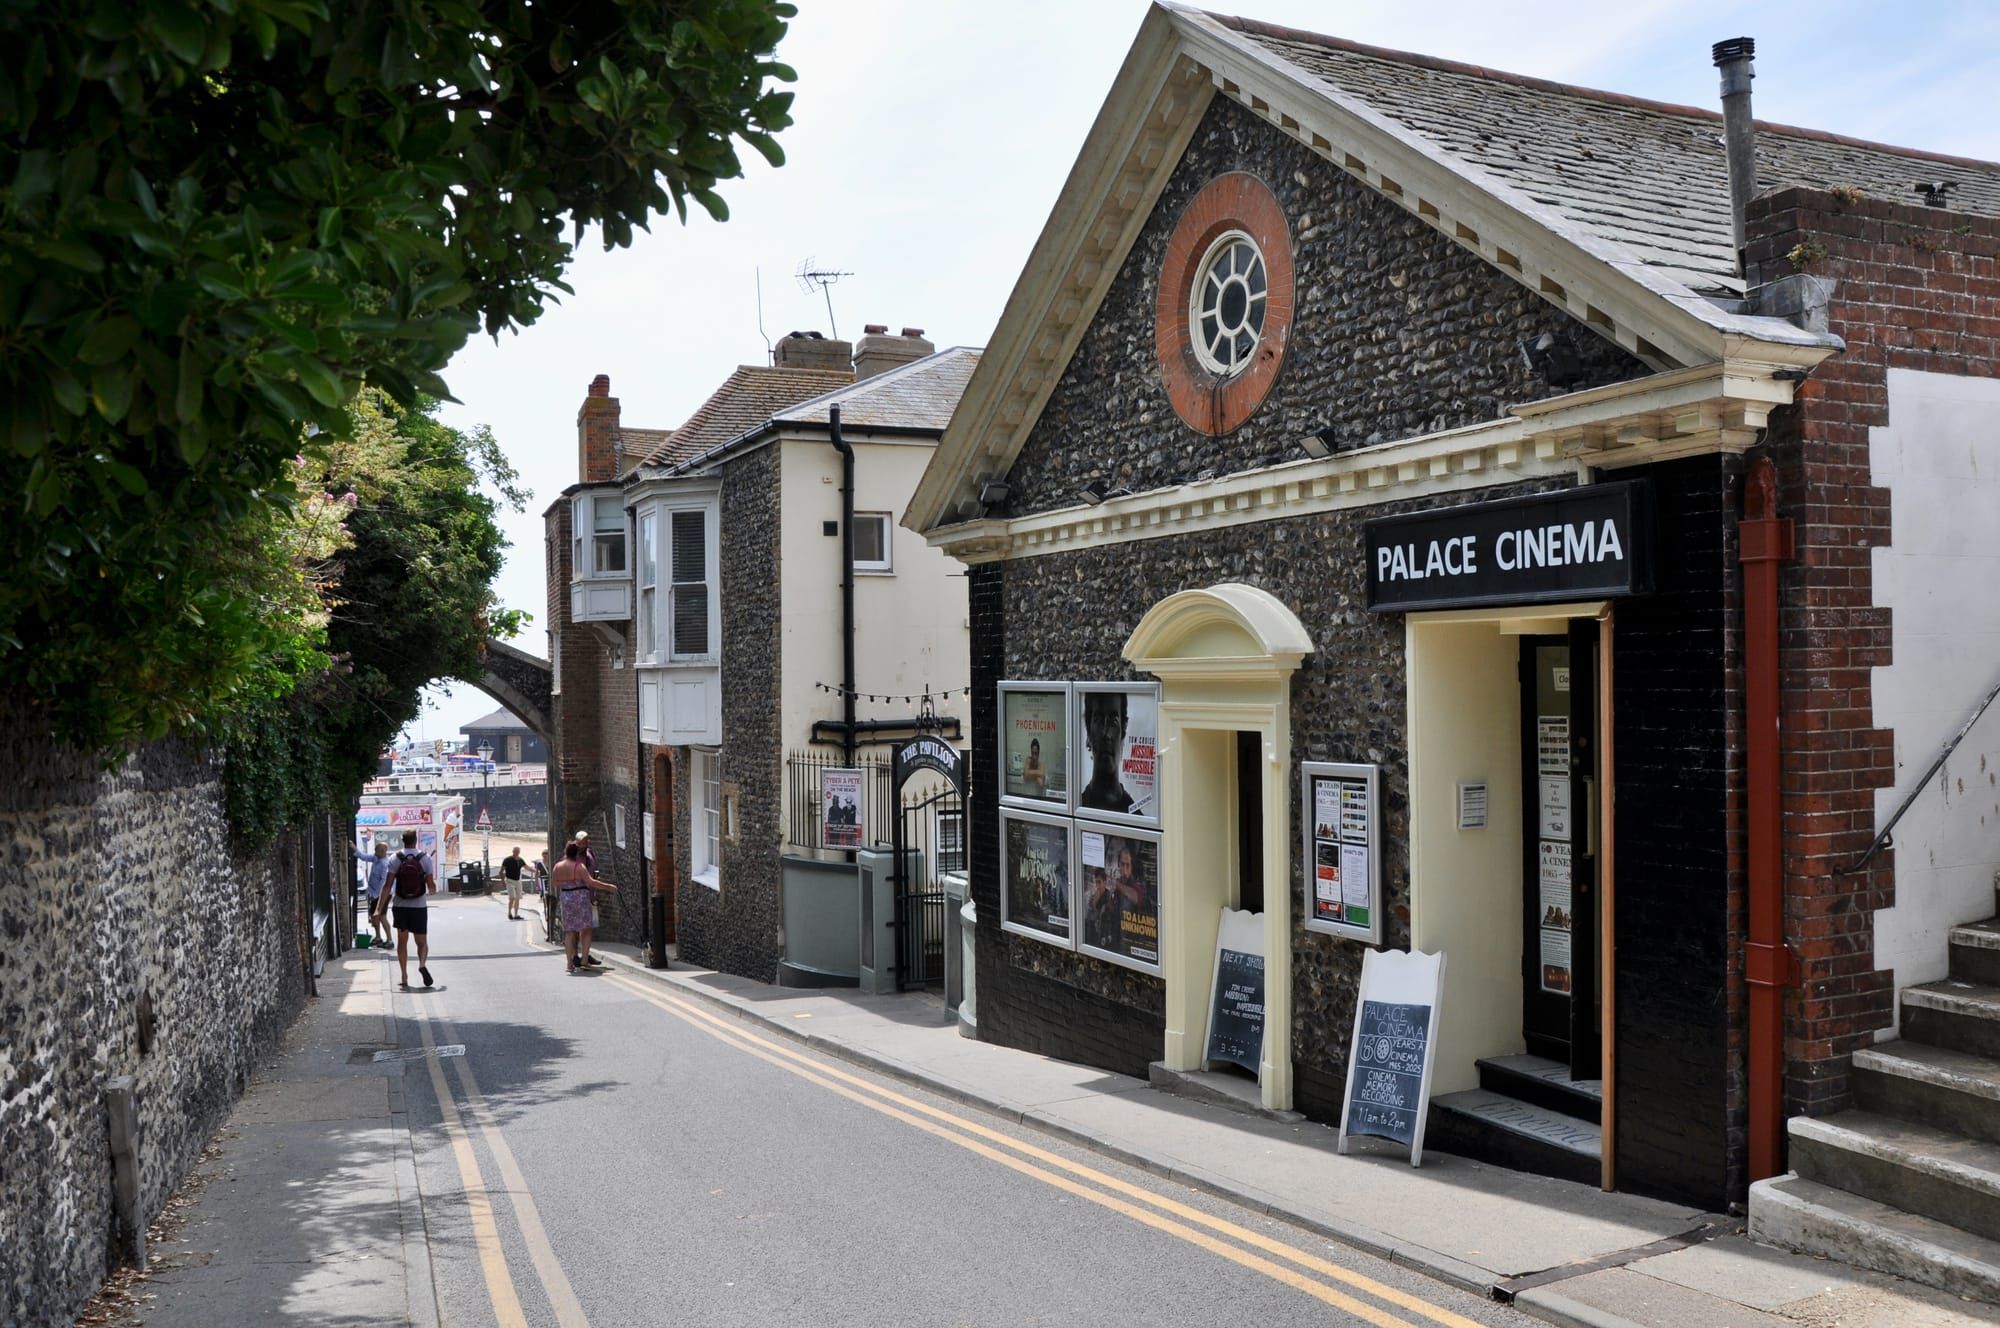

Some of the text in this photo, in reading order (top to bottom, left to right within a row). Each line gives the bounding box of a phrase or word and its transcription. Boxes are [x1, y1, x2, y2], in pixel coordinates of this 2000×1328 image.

[1378, 519, 1623, 582] PALACE CINEMA
[1015, 719, 1057, 731] PHOENICIAN
[901, 742, 918, 763] THE
[920, 741, 956, 770] PAVILION
[1123, 759, 1154, 774] IMPOSSIBLE
[356, 814, 387, 824] eam
[1555, 845, 1571, 855] YEA
[1542, 856, 1570, 867] A CINE
[1122, 911, 1156, 927] TO A LAND
[1120, 920, 1157, 938] UNKNOWN
[1222, 952, 1244, 965] NEXT
[1365, 1005, 1410, 1022] PALACE
[1377, 1021, 1424, 1041] CINEMA
[1360, 1034, 1393, 1063] 60
[1392, 1039, 1424, 1051] YEARS A
[1390, 1051, 1419, 1064] CINEMA
[1367, 1070, 1397, 1084] CINEMA
[1365, 1080, 1399, 1094] MEMORY
[1361, 1089, 1405, 1107] RECORDING
[1380, 1112, 1387, 1125] to
